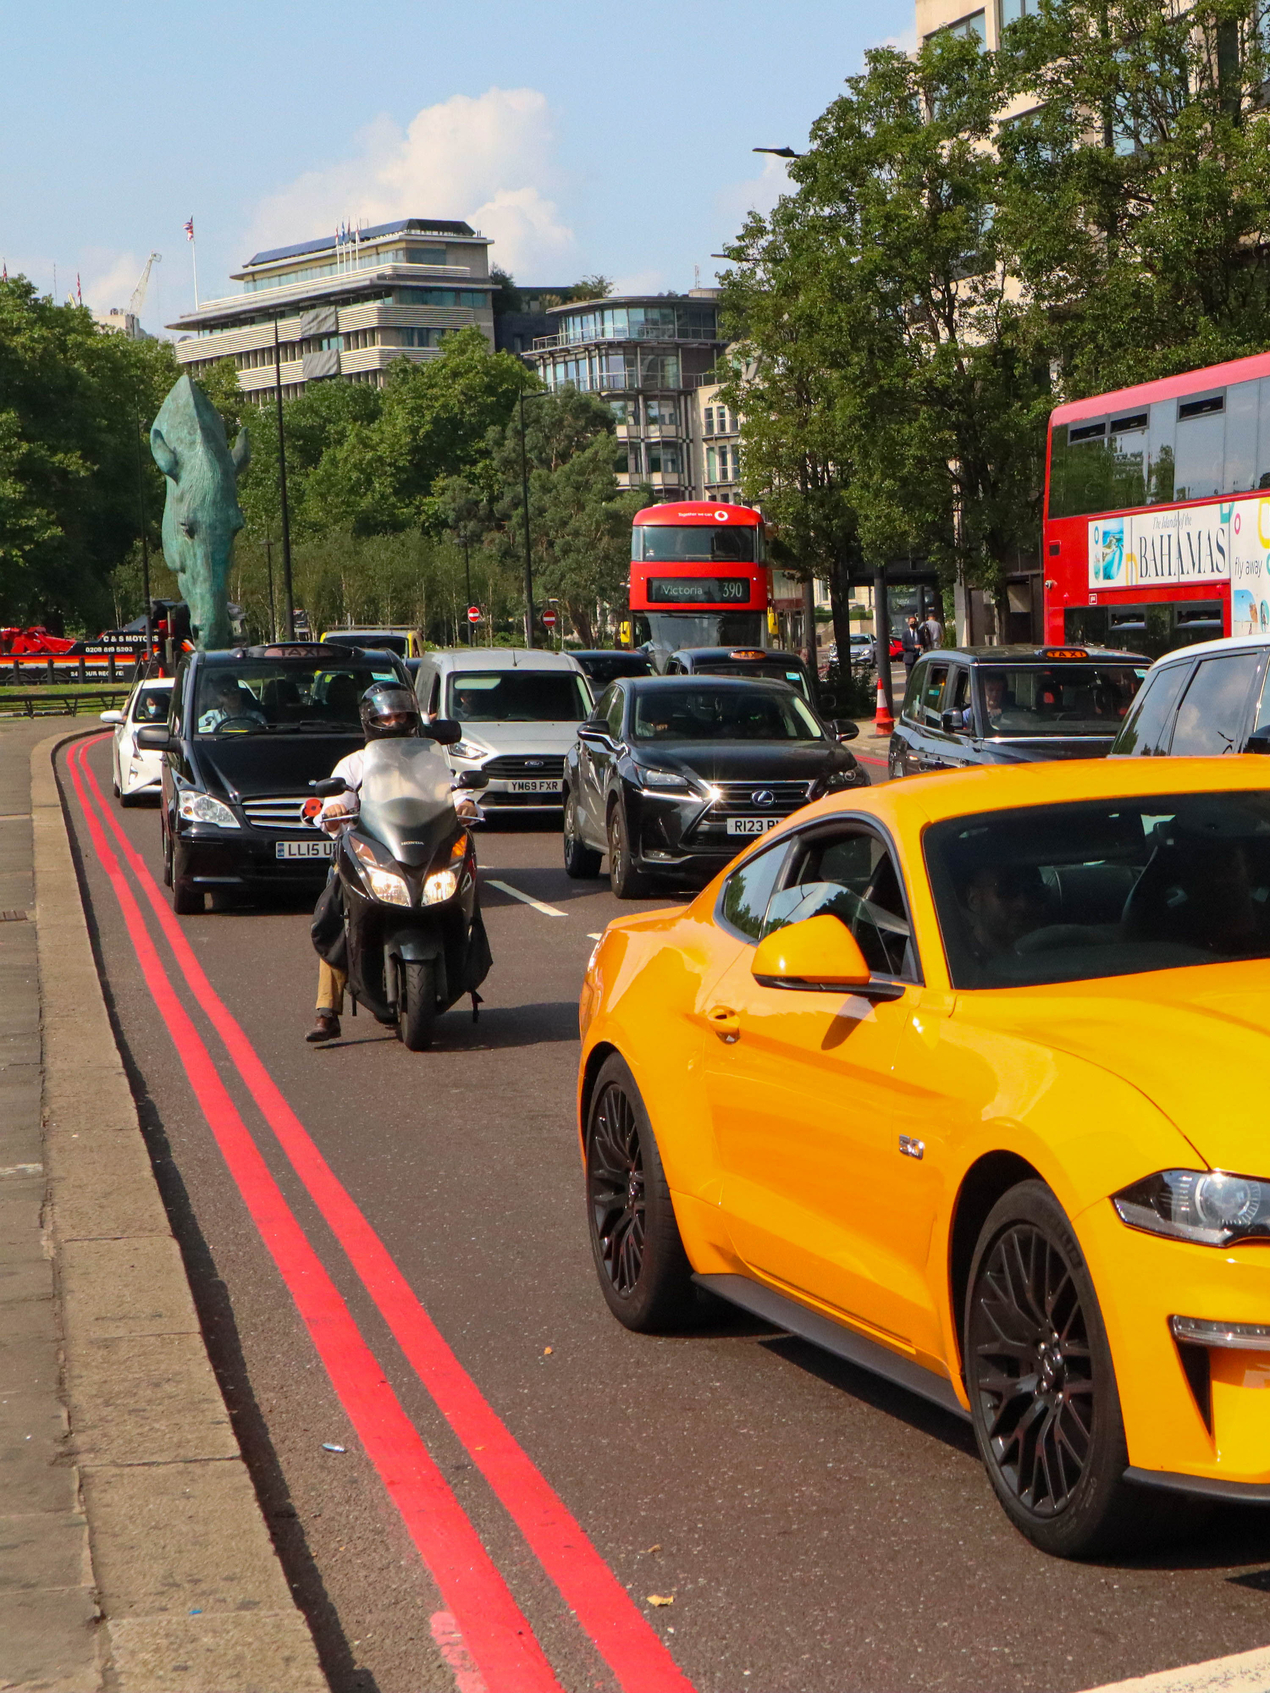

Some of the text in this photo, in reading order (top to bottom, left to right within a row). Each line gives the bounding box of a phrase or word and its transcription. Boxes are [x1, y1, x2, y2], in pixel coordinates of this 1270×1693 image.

[1153, 516, 1161, 529] The
[1139, 528, 1226, 578] BAHAMAS
[1234, 557, 1262, 579] fly away
[662, 582, 743, 598] Victoria 390
[278, 648, 320, 657] TAXI
[511, 780, 558, 793] YM69 FXR
[734, 820, 764, 833] R123
[288, 844, 320, 857] LL15
[324, 843, 337, 856] U
